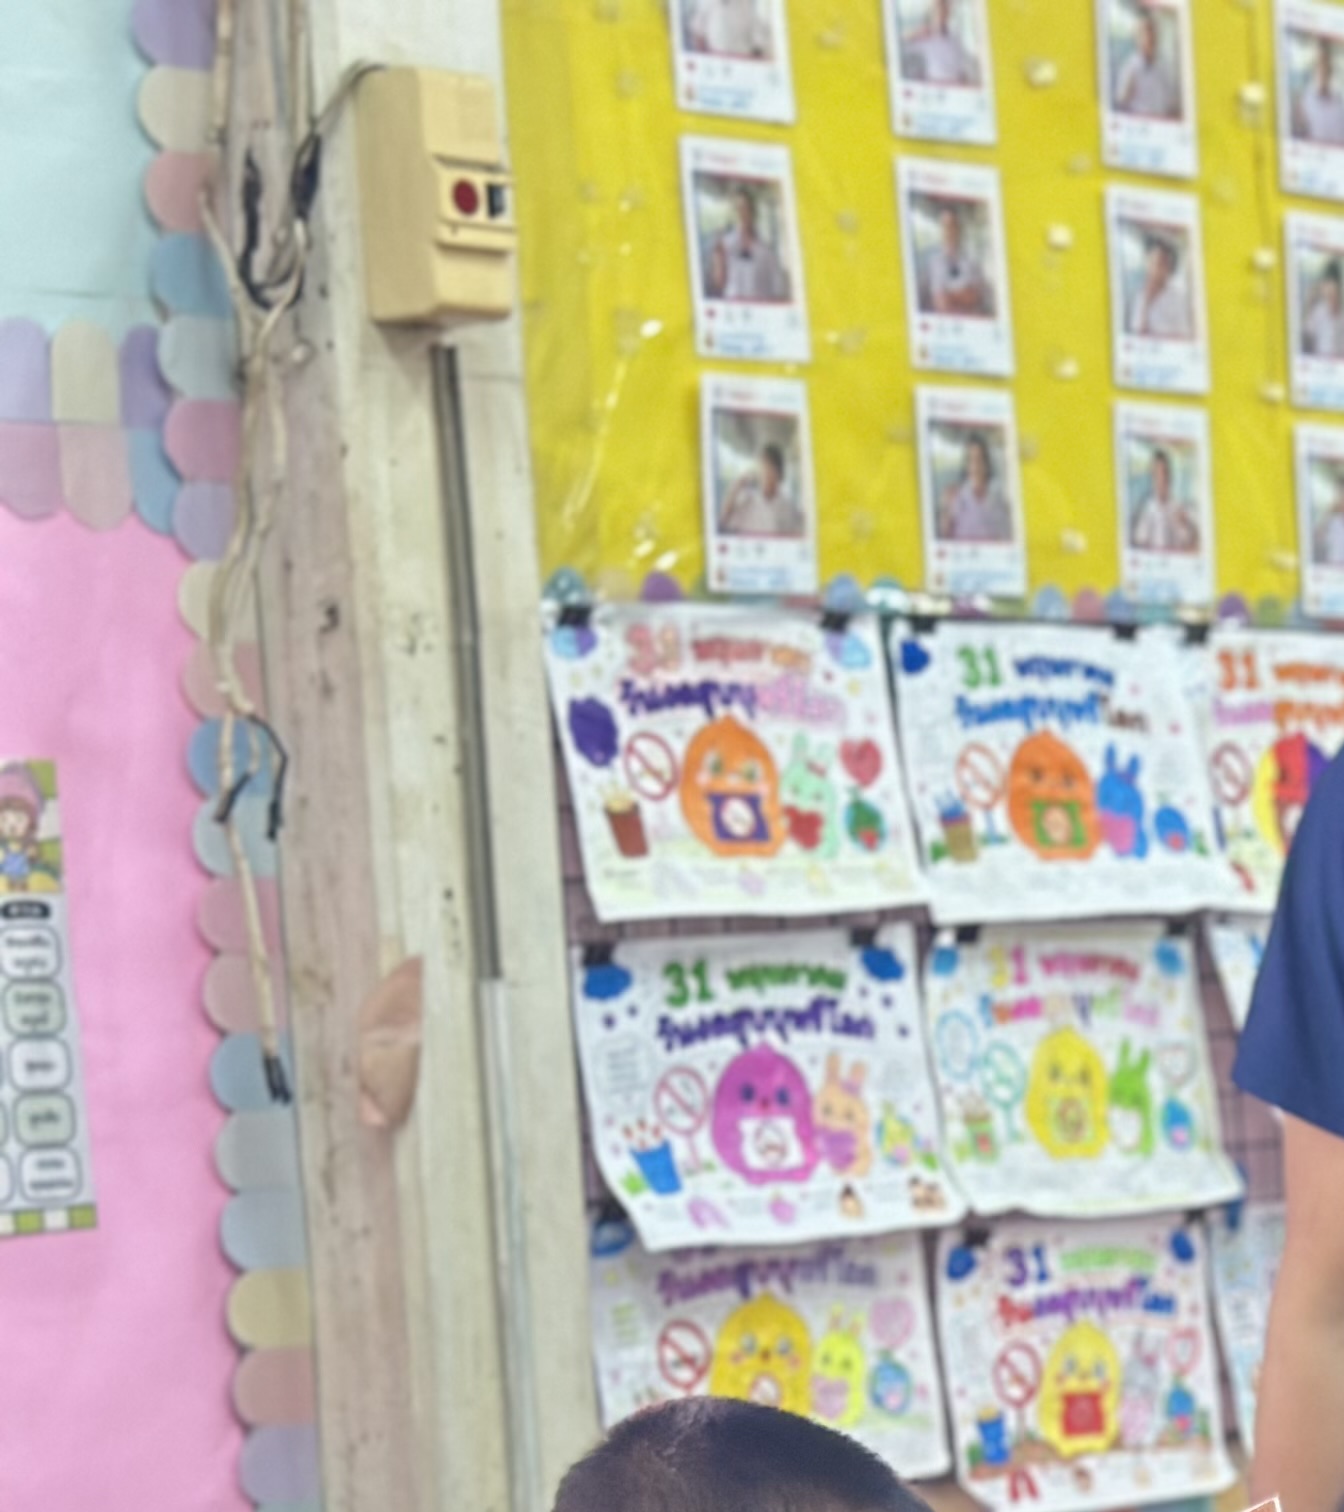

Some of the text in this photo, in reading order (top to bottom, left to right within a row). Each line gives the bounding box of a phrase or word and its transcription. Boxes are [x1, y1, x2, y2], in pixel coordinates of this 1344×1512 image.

[956, 645, 1003, 688] 31
[1217, 651, 1259, 692] 31
[663, 960, 715, 1008] 31
[1004, 1246, 1050, 1288] 31
